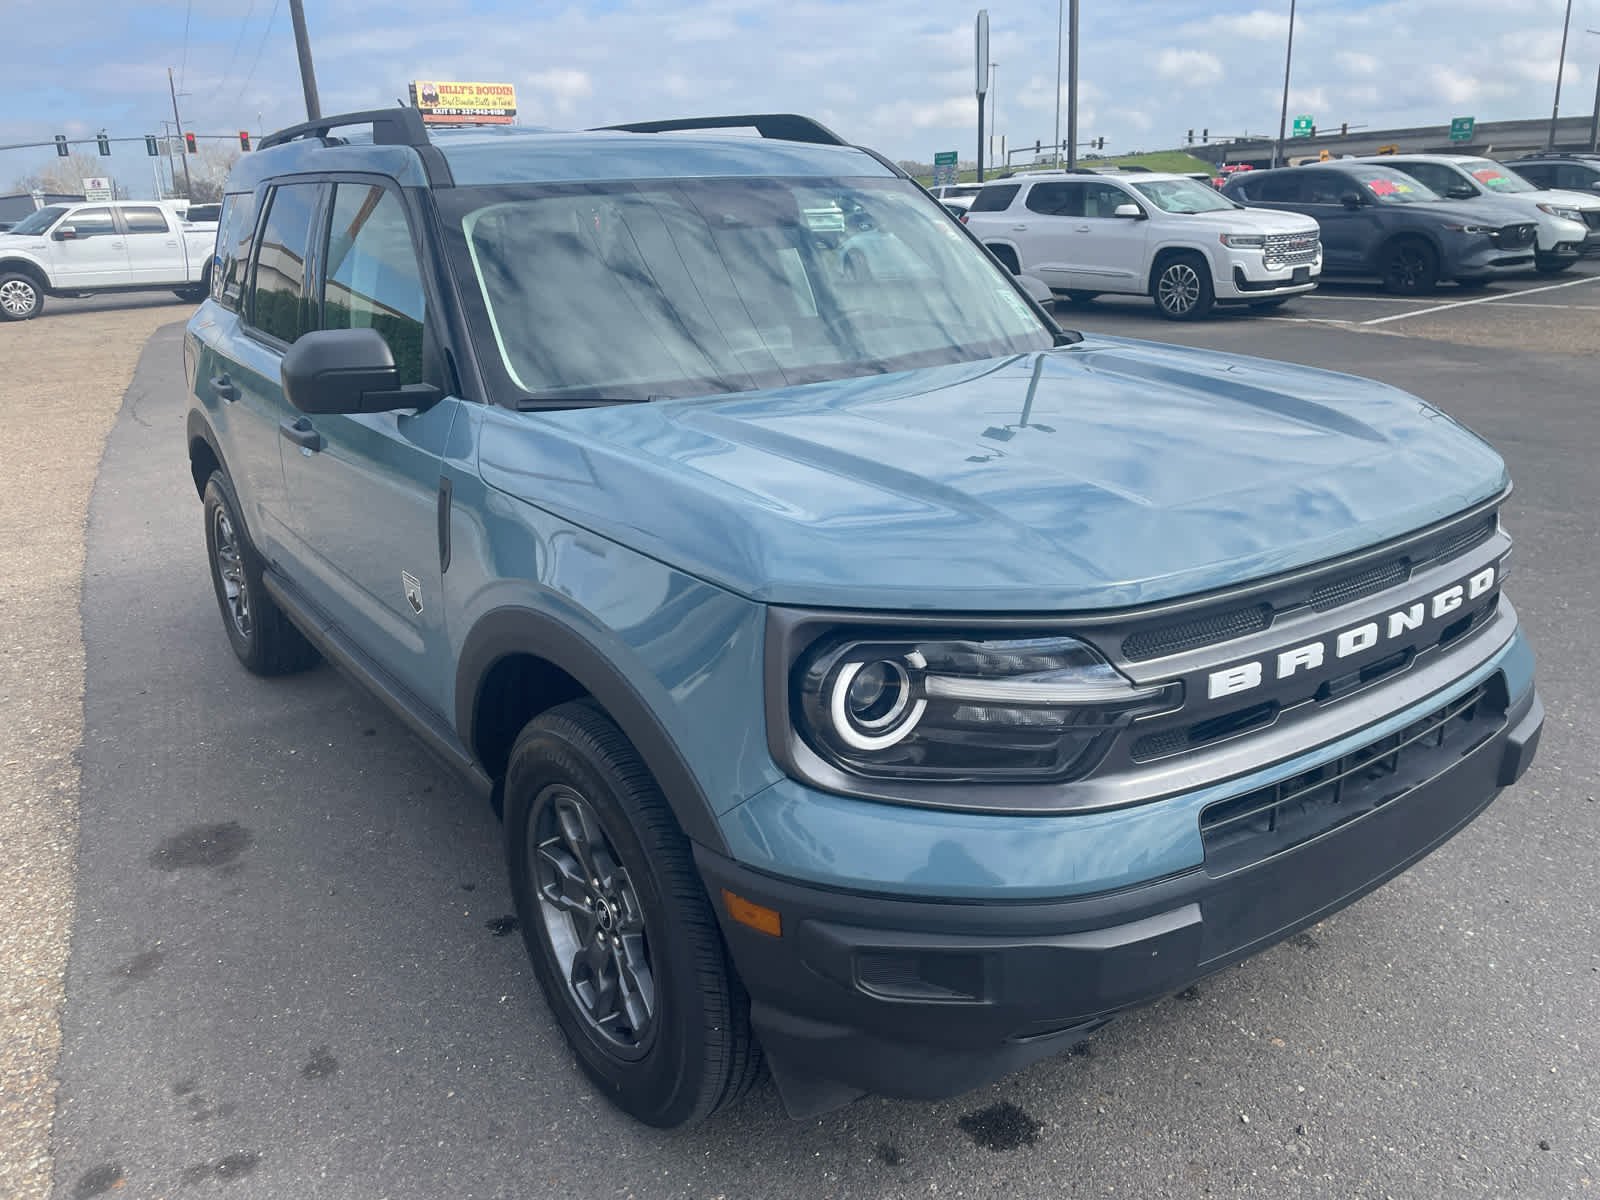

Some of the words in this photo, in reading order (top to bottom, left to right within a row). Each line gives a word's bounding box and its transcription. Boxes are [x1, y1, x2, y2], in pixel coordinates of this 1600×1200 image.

[439, 85, 474, 95] BILLY'S
[476, 86, 513, 96] BOUDIN
[1208, 567, 1495, 699] BRONCO
